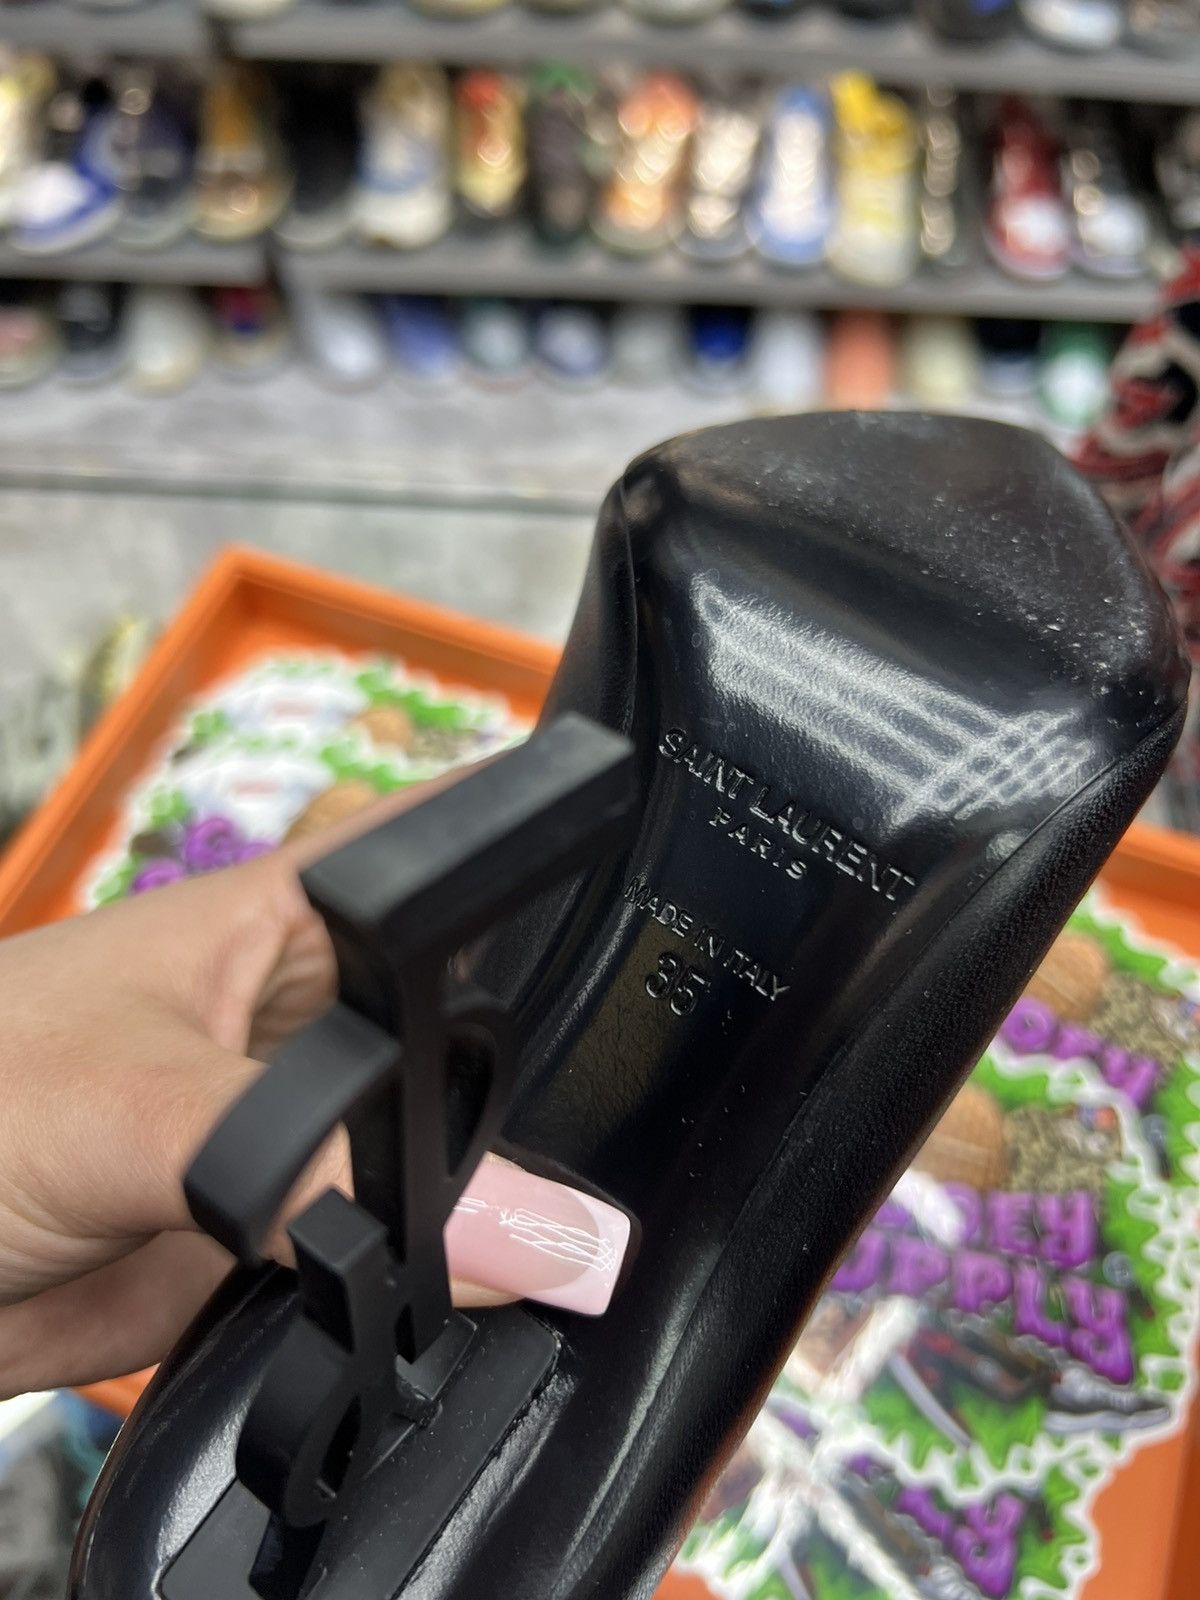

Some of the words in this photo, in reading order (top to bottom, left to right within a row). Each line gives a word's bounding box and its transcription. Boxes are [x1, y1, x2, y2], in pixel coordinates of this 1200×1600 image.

[658, 727, 754, 800] SAINT
[749, 784, 916, 901] LAURENT
[708, 805, 807, 880] PARIS
[624, 872, 694, 938] MADE
[693, 927, 727, 958] IN
[722, 949, 792, 1002] ITALY
[645, 950, 713, 1017] 35
